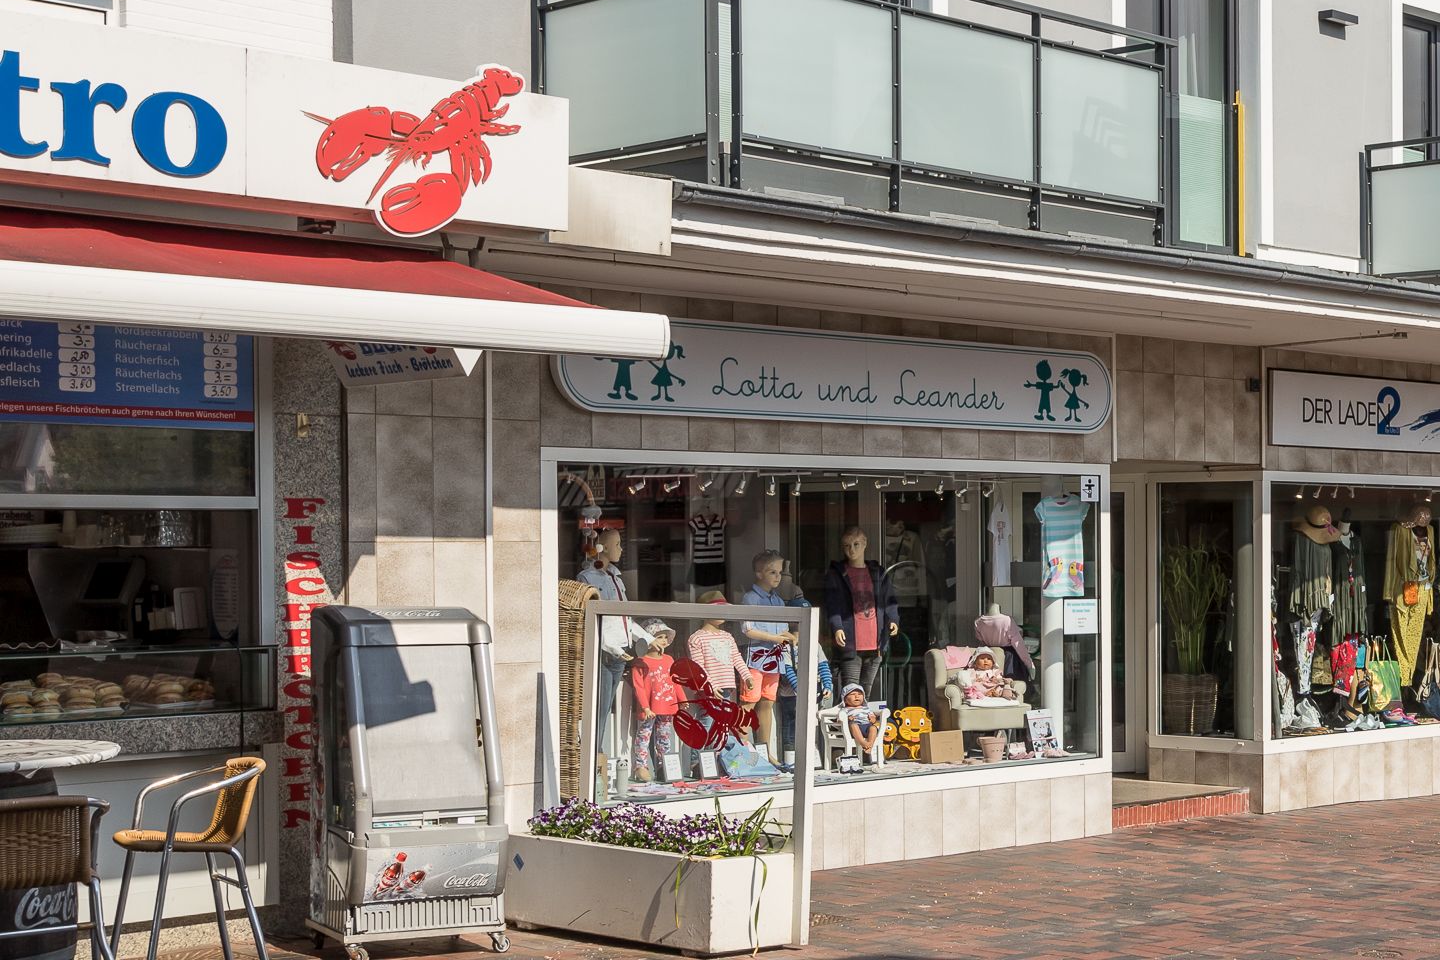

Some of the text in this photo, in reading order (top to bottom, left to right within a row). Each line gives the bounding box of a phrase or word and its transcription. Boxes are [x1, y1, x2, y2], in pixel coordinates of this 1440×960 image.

[114, 340, 171, 352] Räucheraal
[115, 353, 180, 366] Räucherfisch
[115, 367, 182, 380] Räucherlachs
[115, 382, 180, 394] Stremellachs
[712, 357, 1004, 410] Lotta und Leander
[211, 386, 232, 397] 3.50
[55, 406, 111, 415] Fischbrötchen
[196, 411, 236, 419] Wünschen!
[1303, 386, 1400, 436] DER LADEN 2
